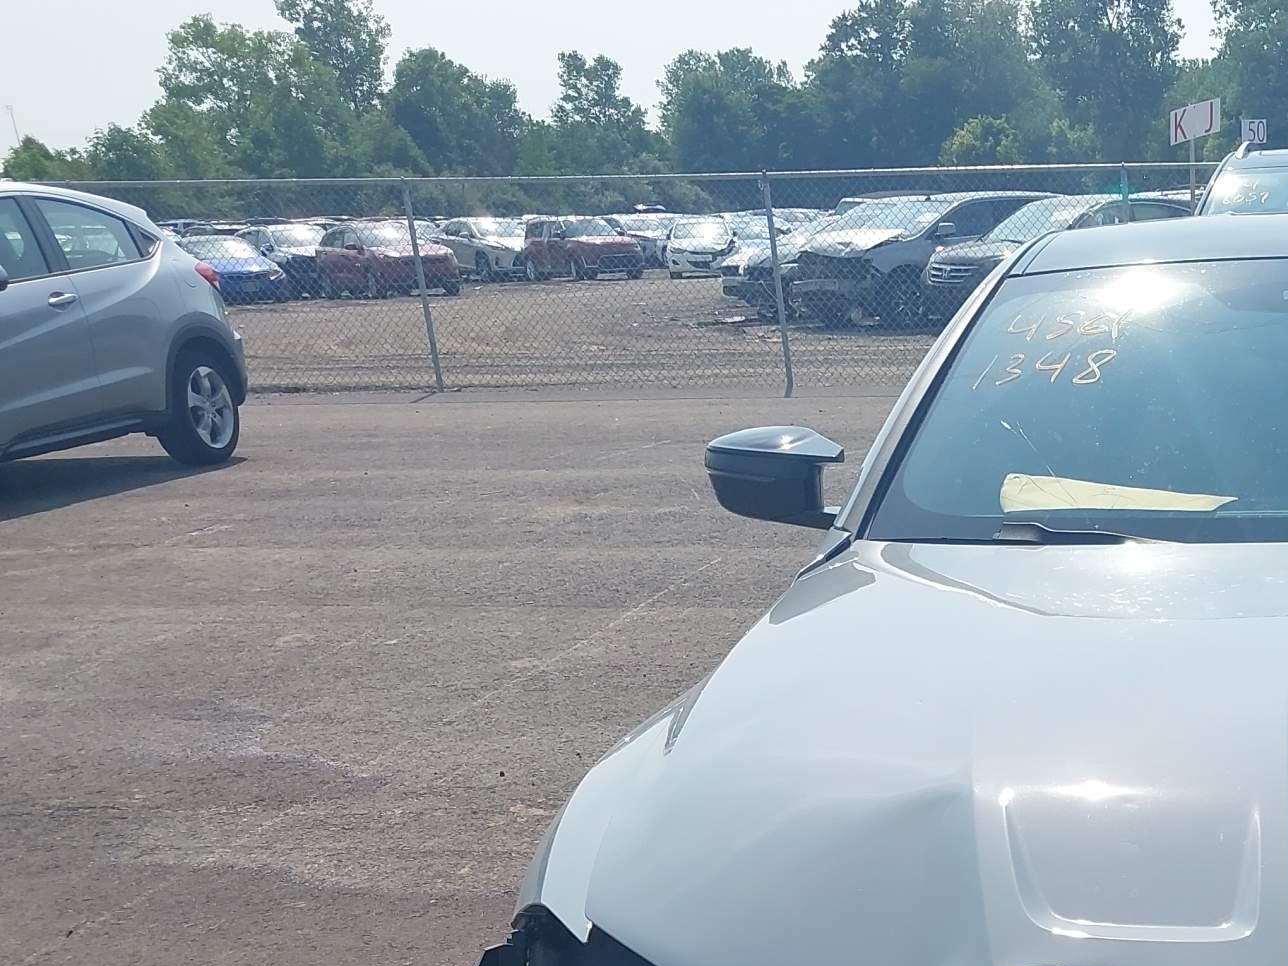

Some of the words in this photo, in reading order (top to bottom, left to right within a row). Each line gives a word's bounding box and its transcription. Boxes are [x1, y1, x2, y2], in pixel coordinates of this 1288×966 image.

[1174, 108, 1188, 143] K
[1204, 101, 1214, 134] J
[1248, 121, 1265, 142] 50
[972, 349, 1116, 390] 1348
